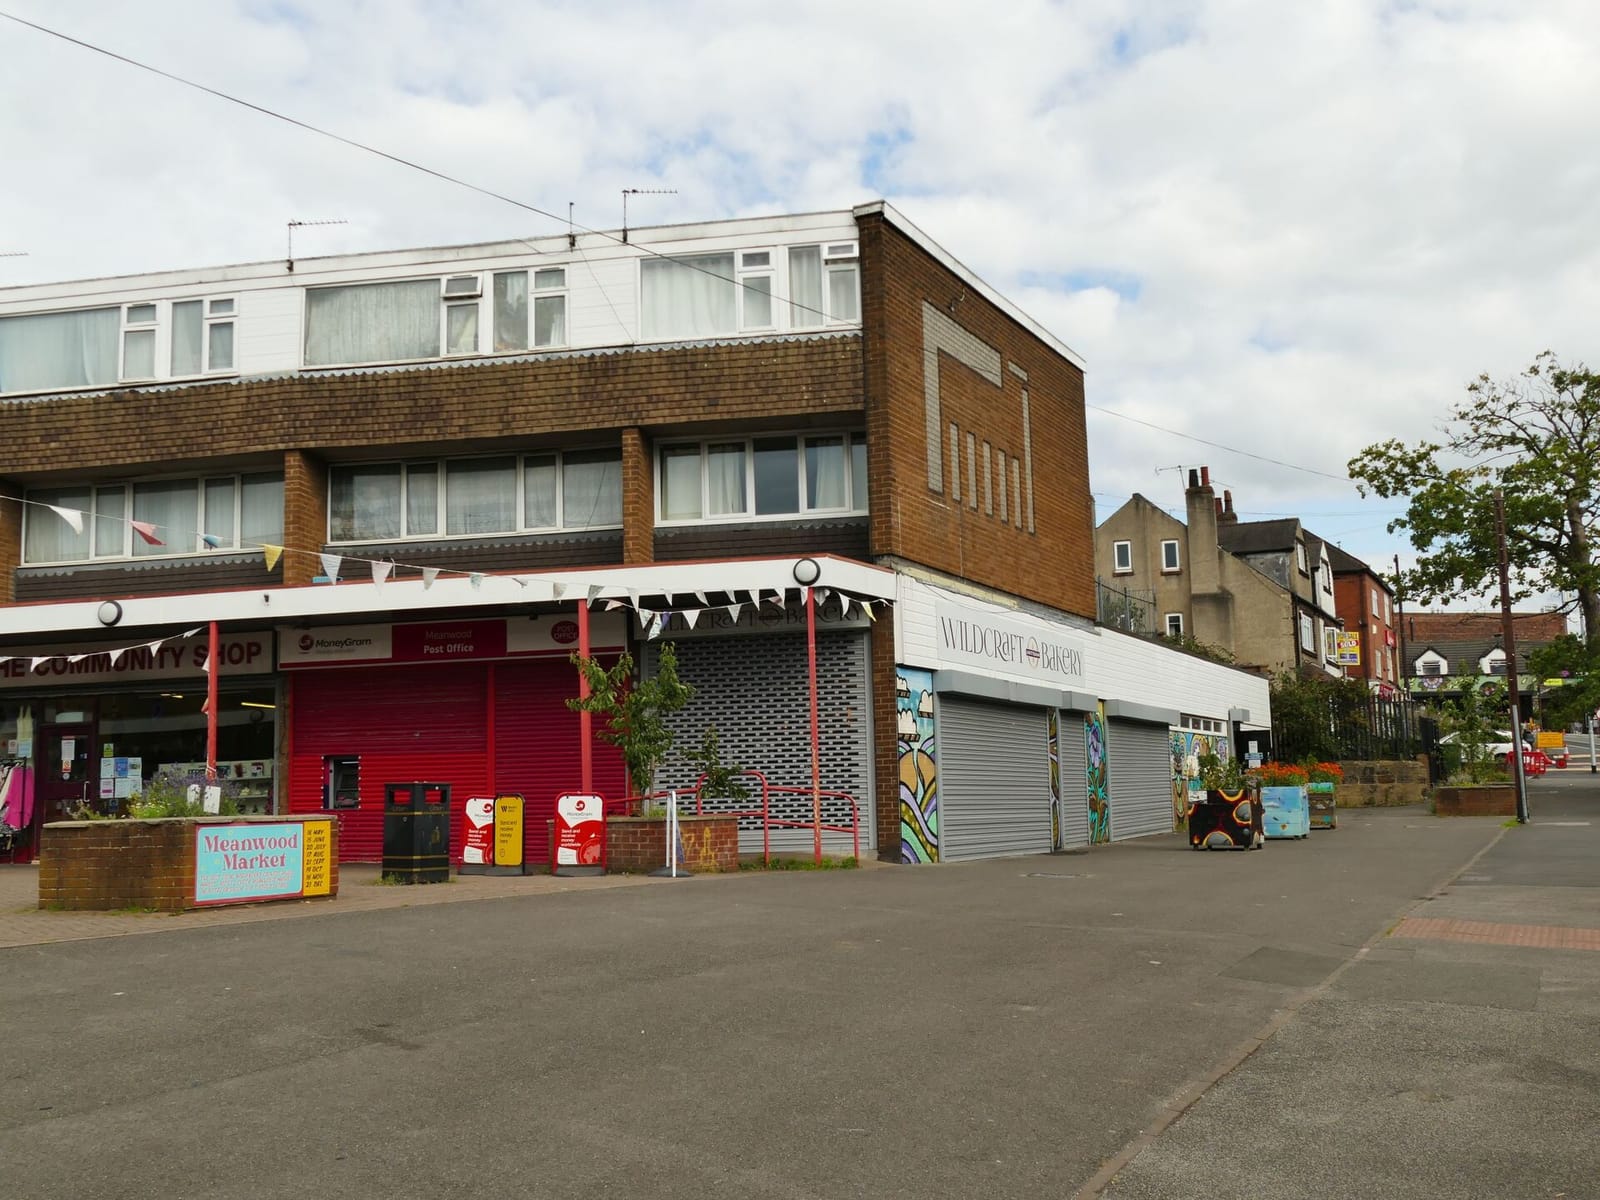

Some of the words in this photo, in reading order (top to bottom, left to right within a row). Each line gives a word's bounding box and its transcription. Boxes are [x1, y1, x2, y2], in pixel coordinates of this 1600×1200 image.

[425, 629, 473, 641] Meanwood
[315, 637, 372, 650] MoneyGram
[423, 644, 445, 654] Post
[447, 643, 475, 653] Office
[35, 646, 187, 677] COMMUNITY
[204, 832, 298, 853] Meanwood
[223, 853, 287, 871] Market
